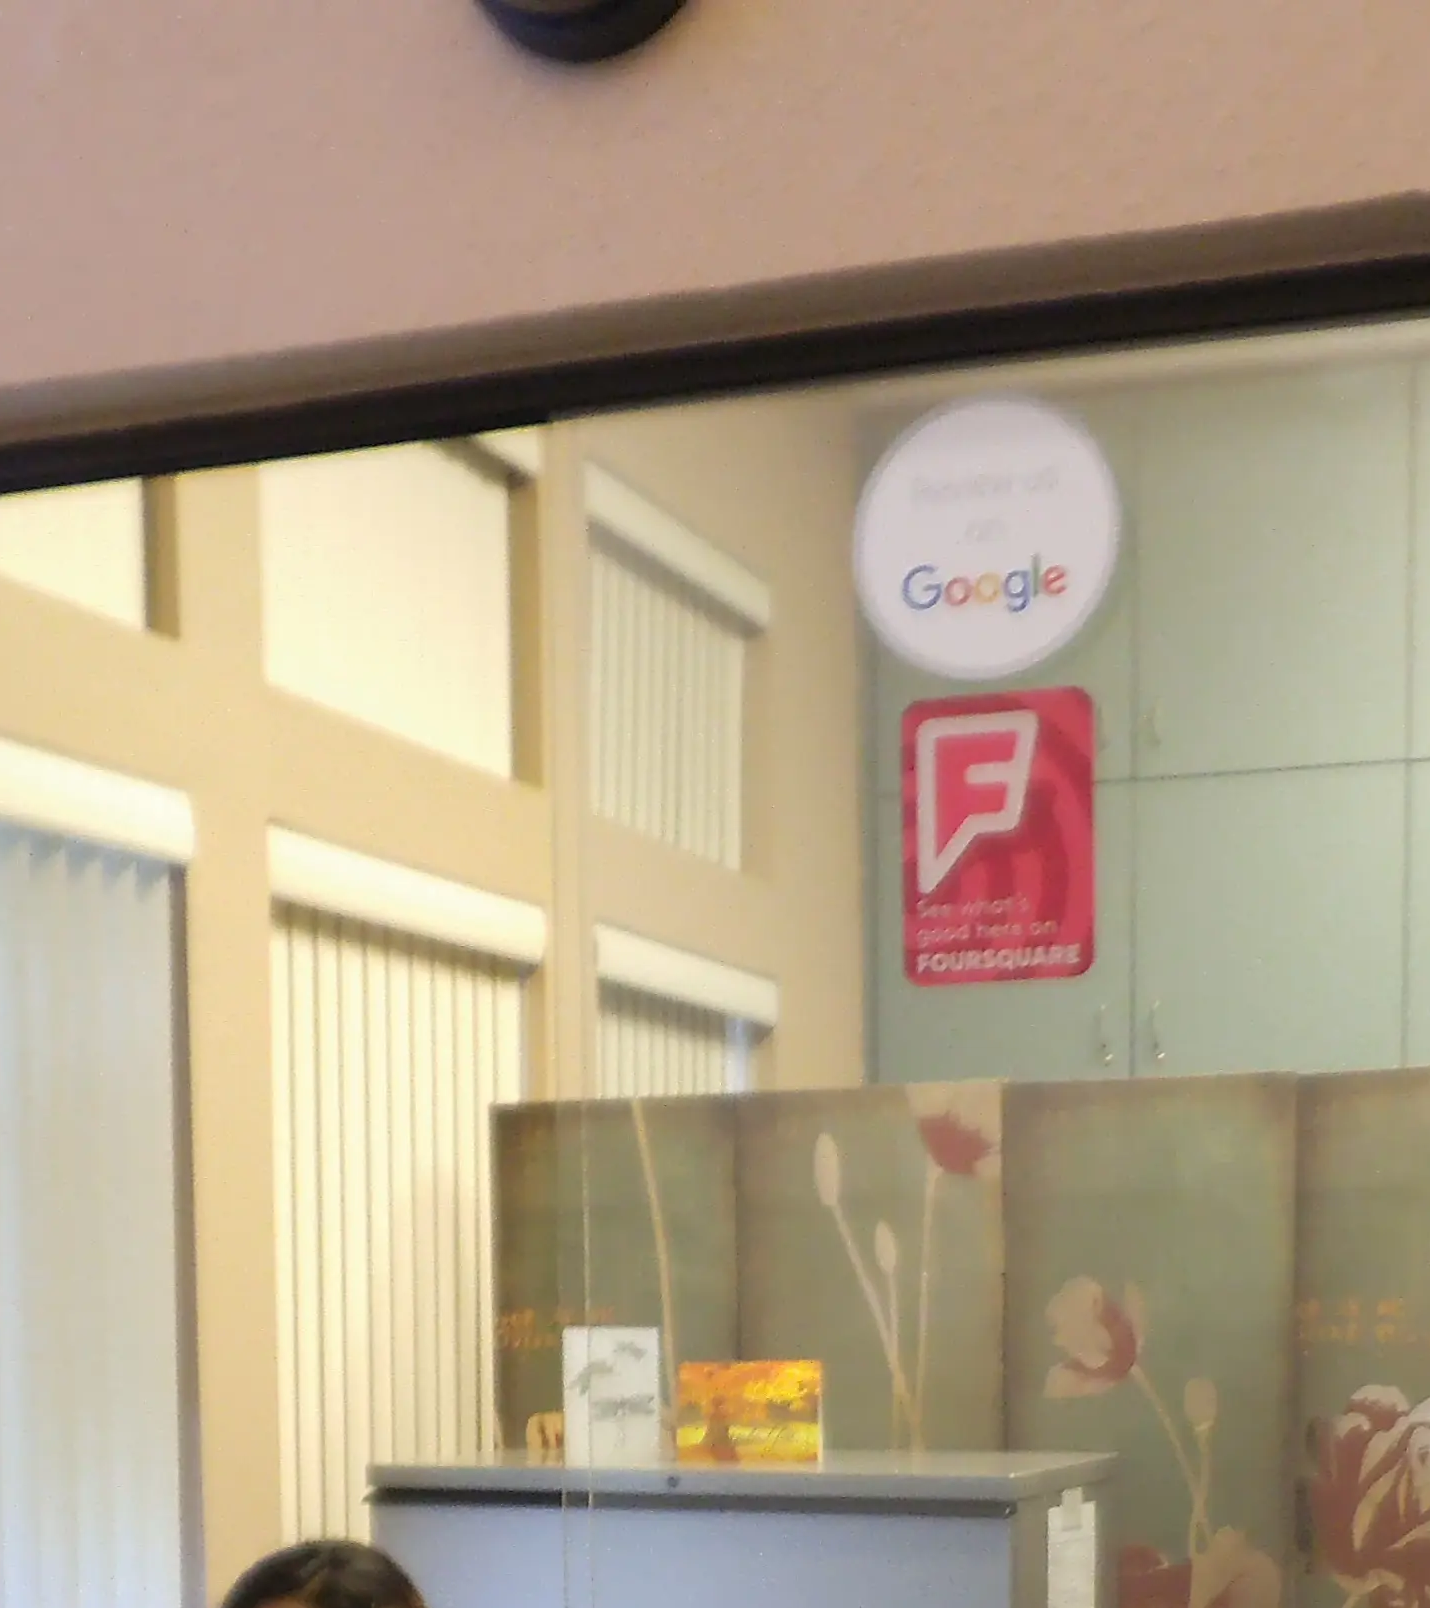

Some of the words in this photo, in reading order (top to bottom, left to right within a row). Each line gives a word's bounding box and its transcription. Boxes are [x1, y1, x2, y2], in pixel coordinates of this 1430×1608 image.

[902, 553, 1068, 613] Google
[1028, 919, 1060, 937] on
[917, 943, 1082, 974] FOURSQUARE
